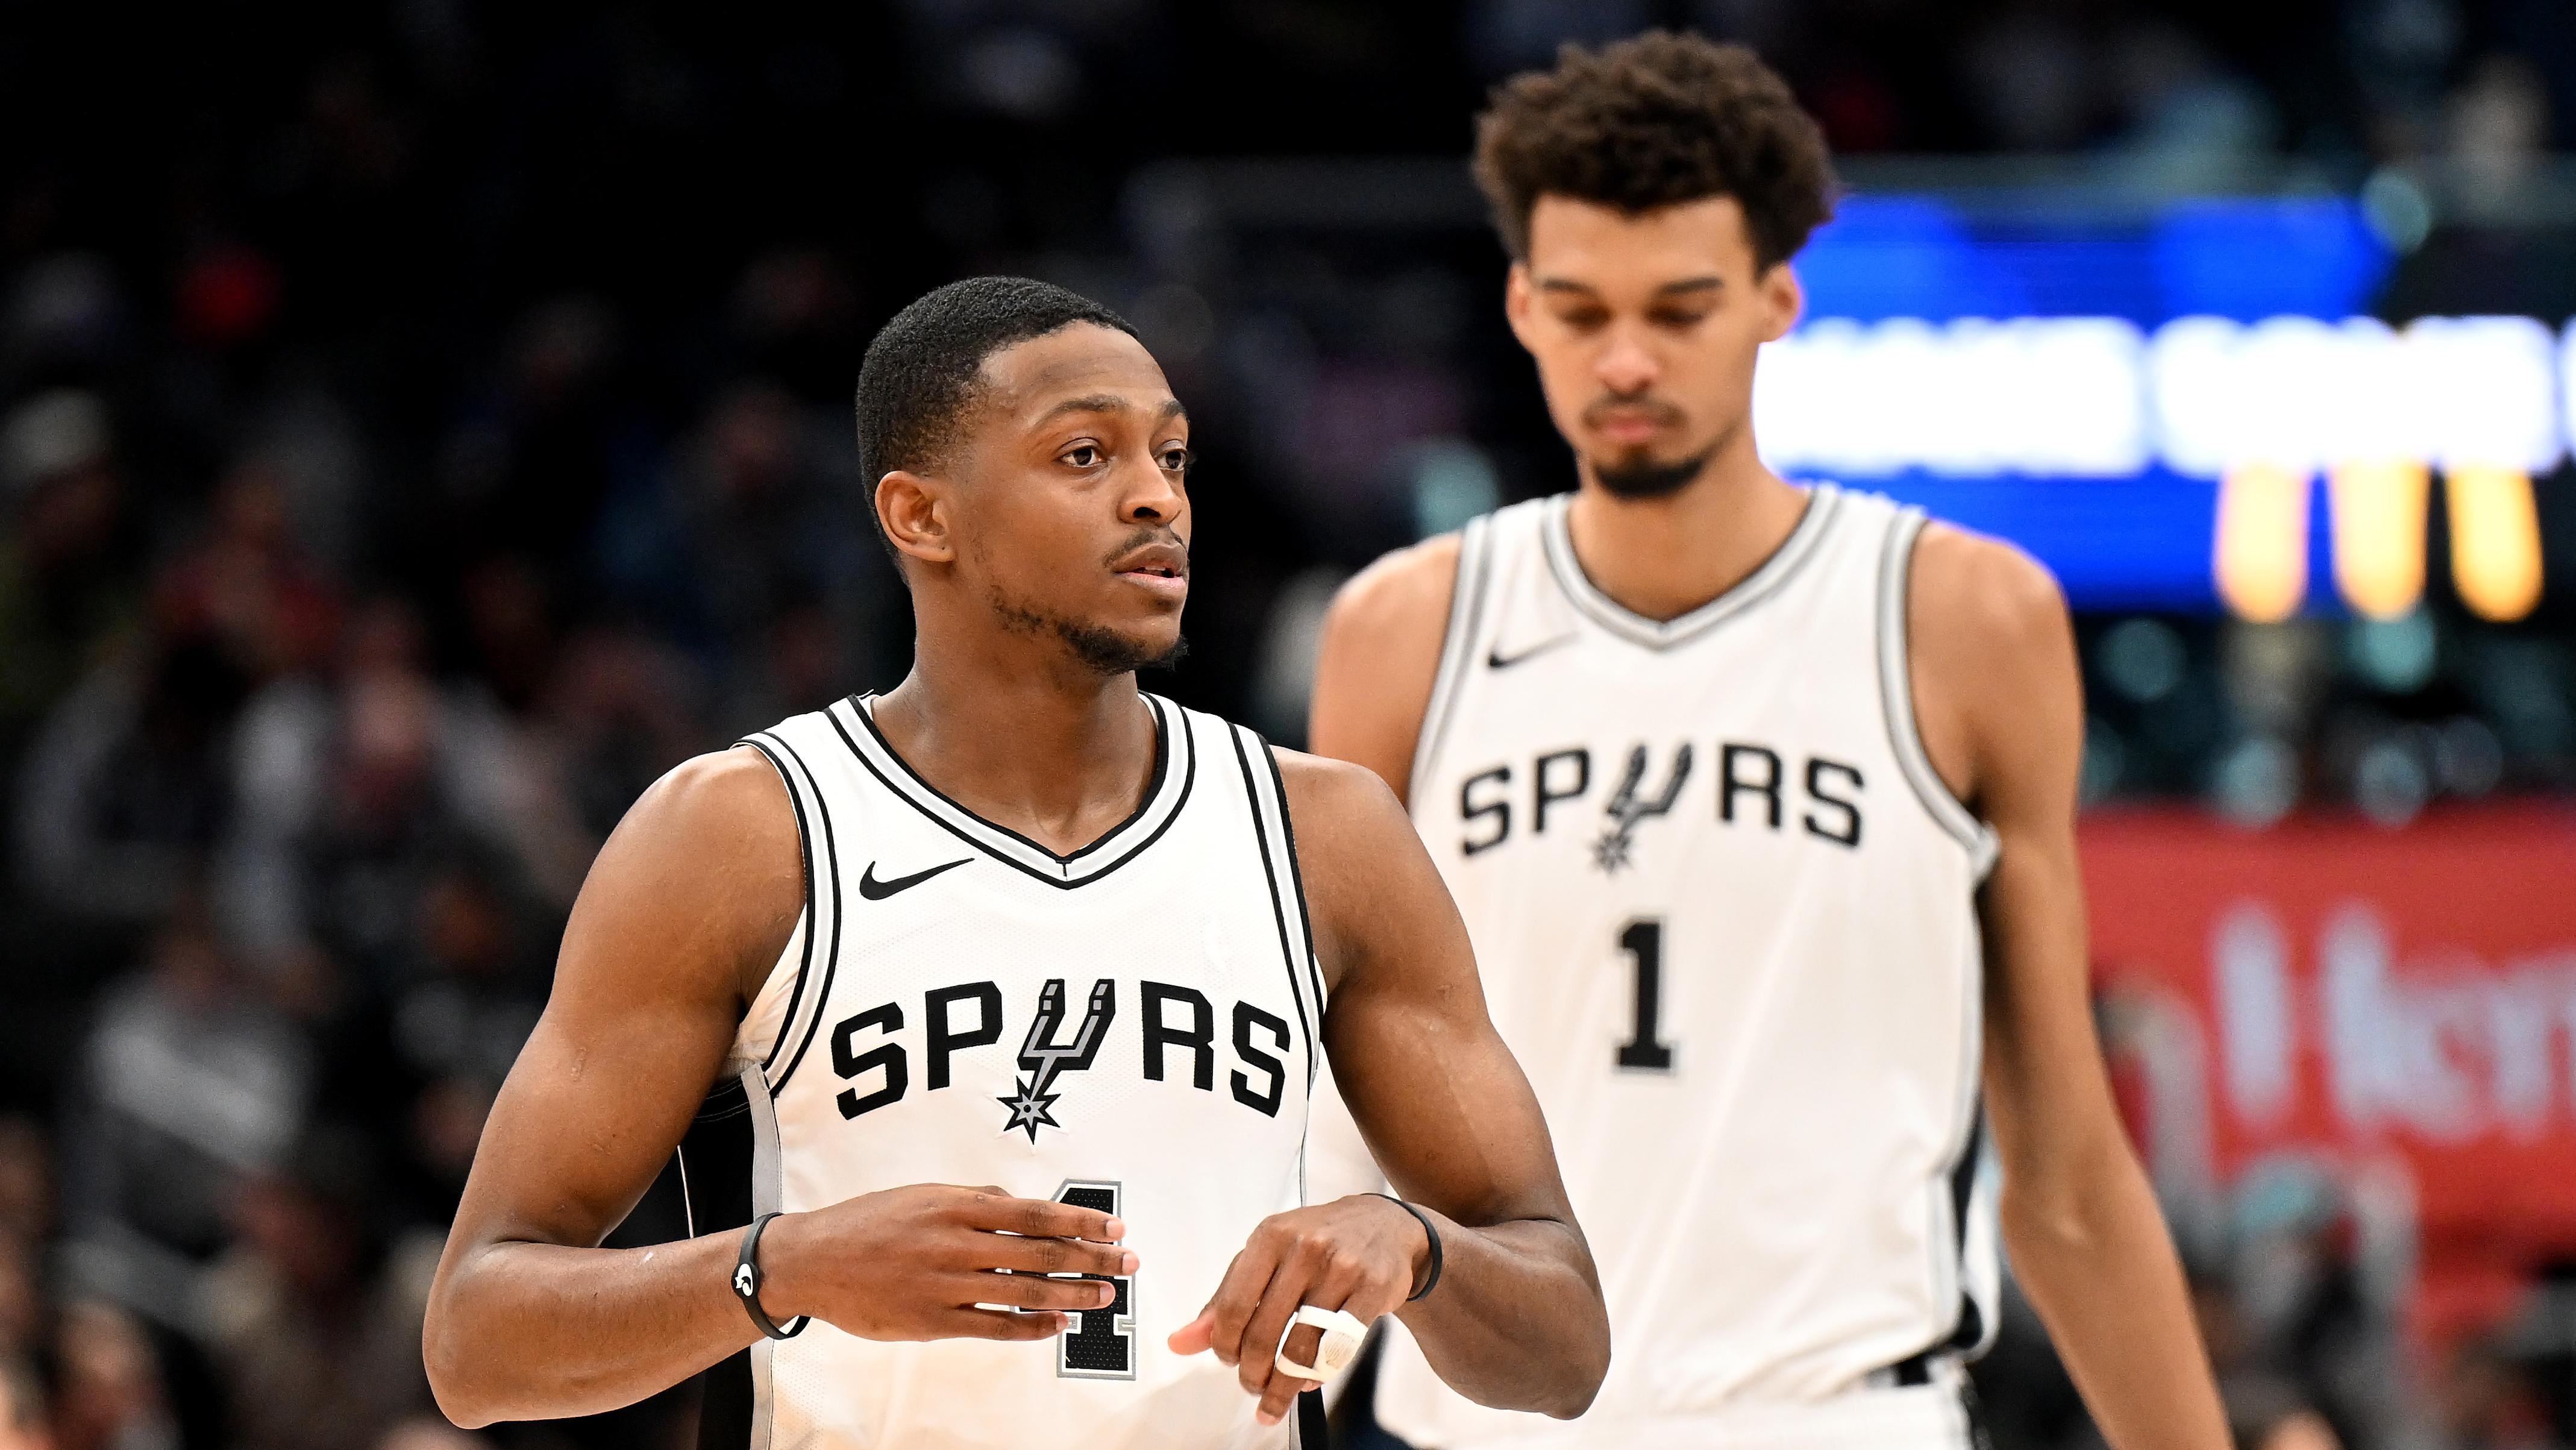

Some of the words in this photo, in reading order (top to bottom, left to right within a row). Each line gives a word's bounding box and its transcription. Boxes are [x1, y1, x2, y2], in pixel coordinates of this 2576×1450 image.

[1459, 742, 1866, 874] SPURS
[830, 978, 1291, 1144] SPURS
[1614, 915, 1675, 1072] 1
